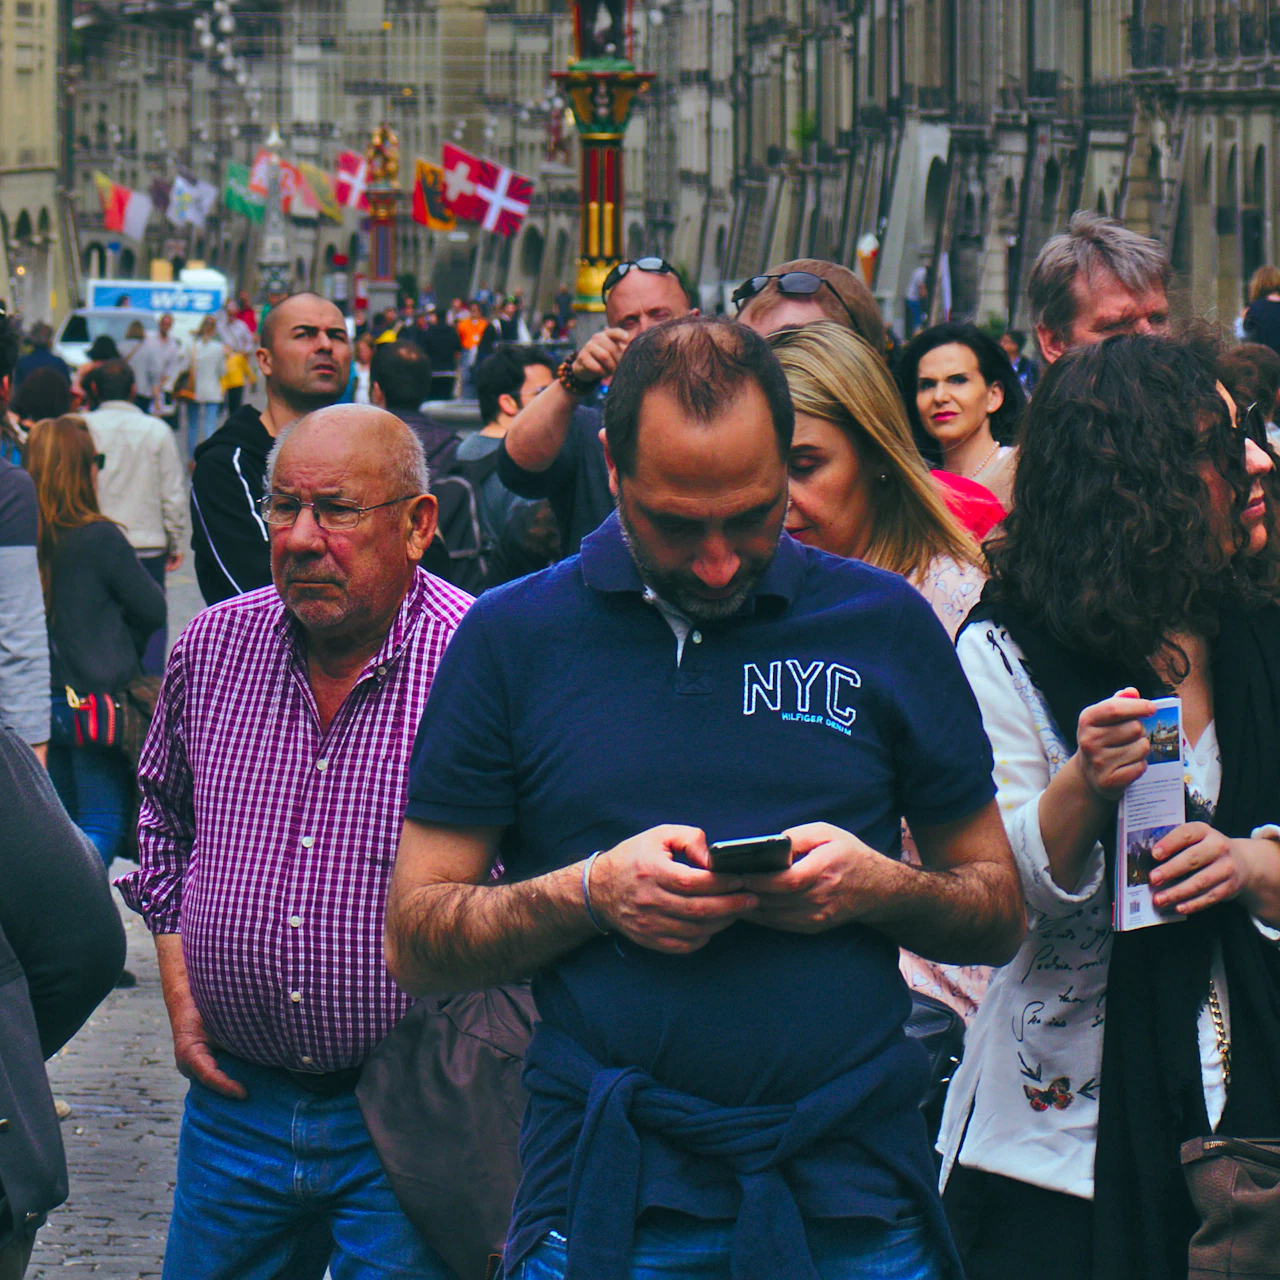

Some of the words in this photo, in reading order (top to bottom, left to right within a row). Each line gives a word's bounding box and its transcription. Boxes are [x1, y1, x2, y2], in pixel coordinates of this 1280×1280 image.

[743, 659, 861, 726] NYC
[781, 712, 823, 724] HILFIGER
[825, 718, 852, 736] DENIM
